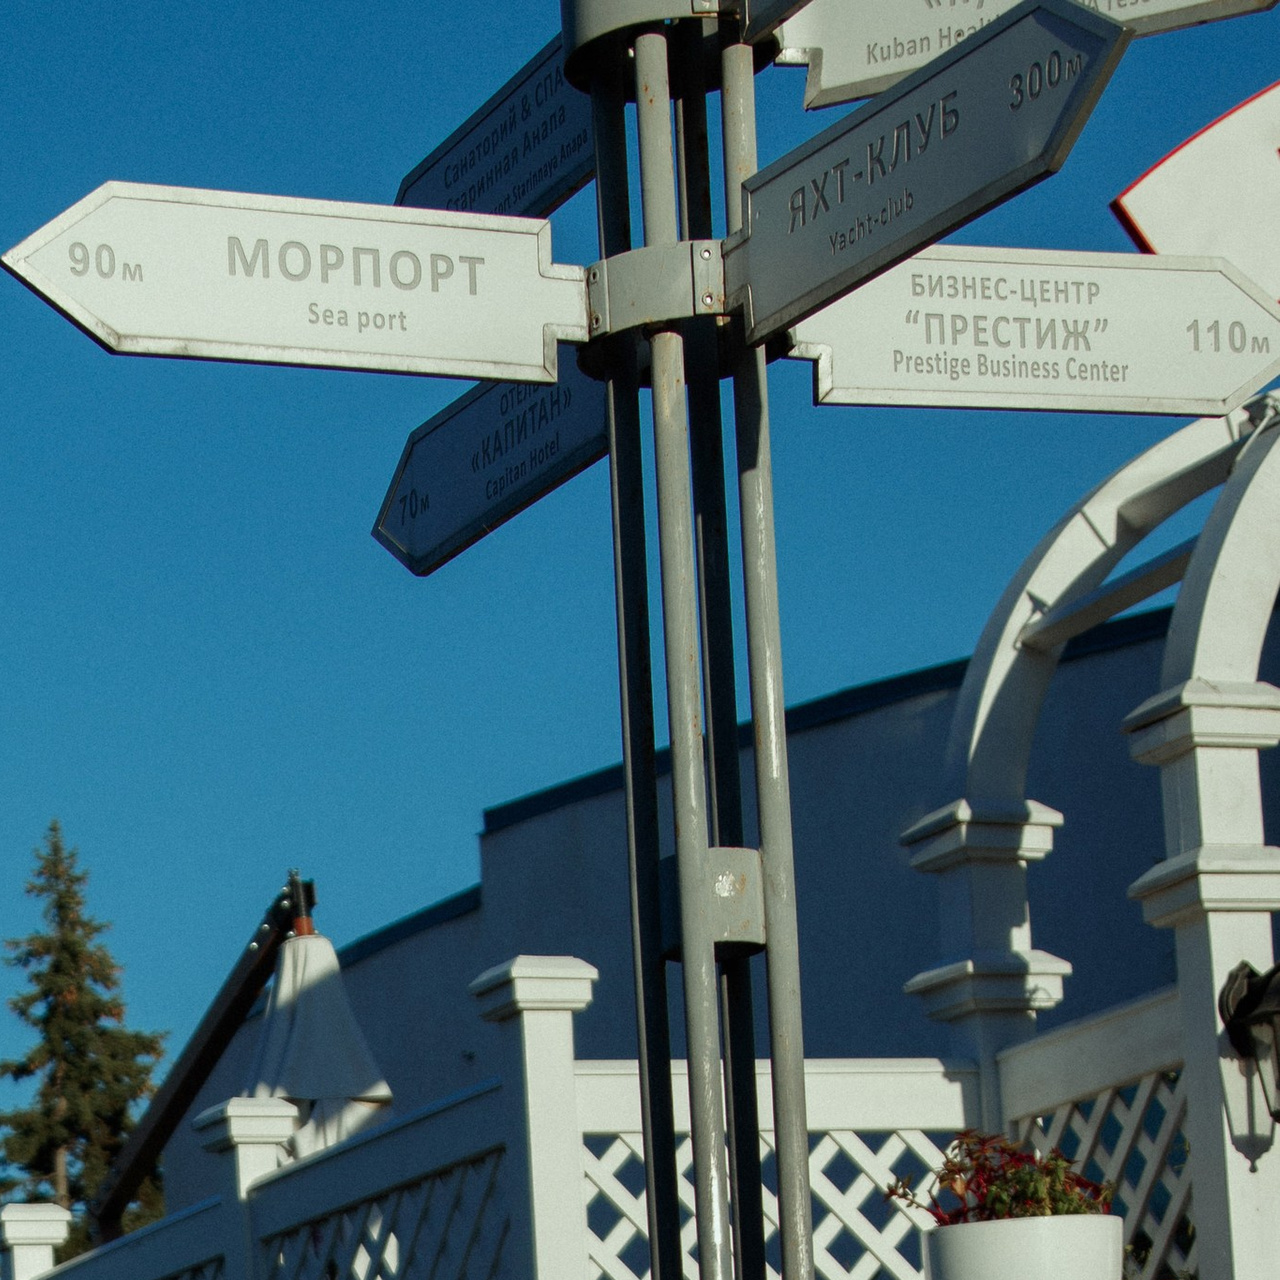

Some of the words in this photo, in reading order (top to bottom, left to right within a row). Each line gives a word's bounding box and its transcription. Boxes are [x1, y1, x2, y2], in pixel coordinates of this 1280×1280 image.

[866, 36, 931, 65] Kuban
[444, 106, 517, 189] Санаторий
[521, 93, 532, 122] &
[535, 65, 564, 108] СПА
[523, 104, 566, 158] Анапа
[512, 155, 558, 203] Starinnaya
[560, 127, 589, 162] Anapa
[787, 90, 961, 234] ЯХТ-КЛУБ
[828, 187, 914, 256] Yacht-club
[226, 235, 485, 296] МОРПОРТ
[911, 274, 1100, 305] БИЗНЕС-ЦЕНТР
[307, 302, 350, 329] Sea
[358, 306, 407, 333] port
[892, 350, 972, 381] Prestige
[977, 354, 1061, 380] Business
[1066, 356, 1129, 382] Center
[470, 386, 572, 474] «КАПИТАН»
[485, 459, 527, 501] Capitan
[530, 432, 561, 469] Hotel
